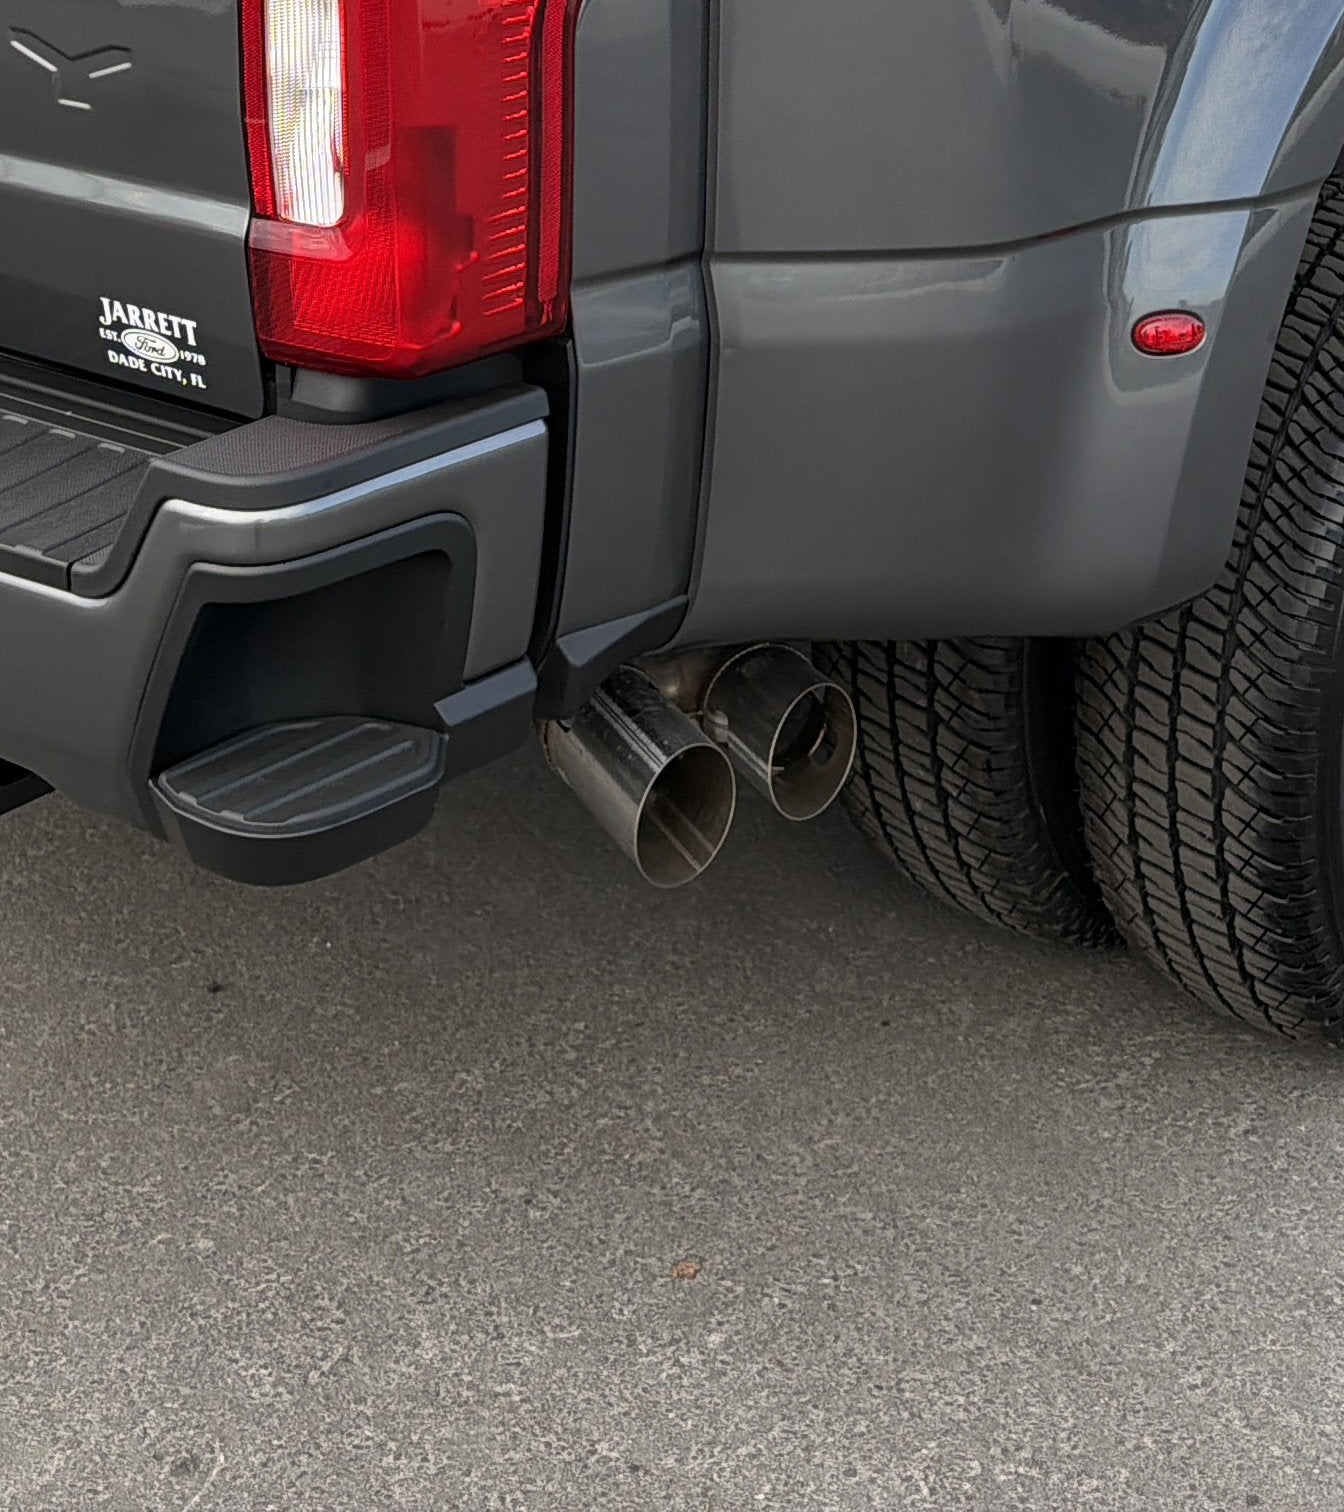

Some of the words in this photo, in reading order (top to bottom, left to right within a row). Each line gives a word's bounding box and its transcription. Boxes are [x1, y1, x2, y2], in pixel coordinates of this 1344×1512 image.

[99, 296, 197, 347] JARRETT
[99, 327, 122, 343] EST.
[135, 335, 166, 357] Ford
[180, 350, 206, 366] 1978
[107, 349, 148, 372] DADE
[150, 361, 188, 386] CITY,
[190, 372, 207, 389] FL
